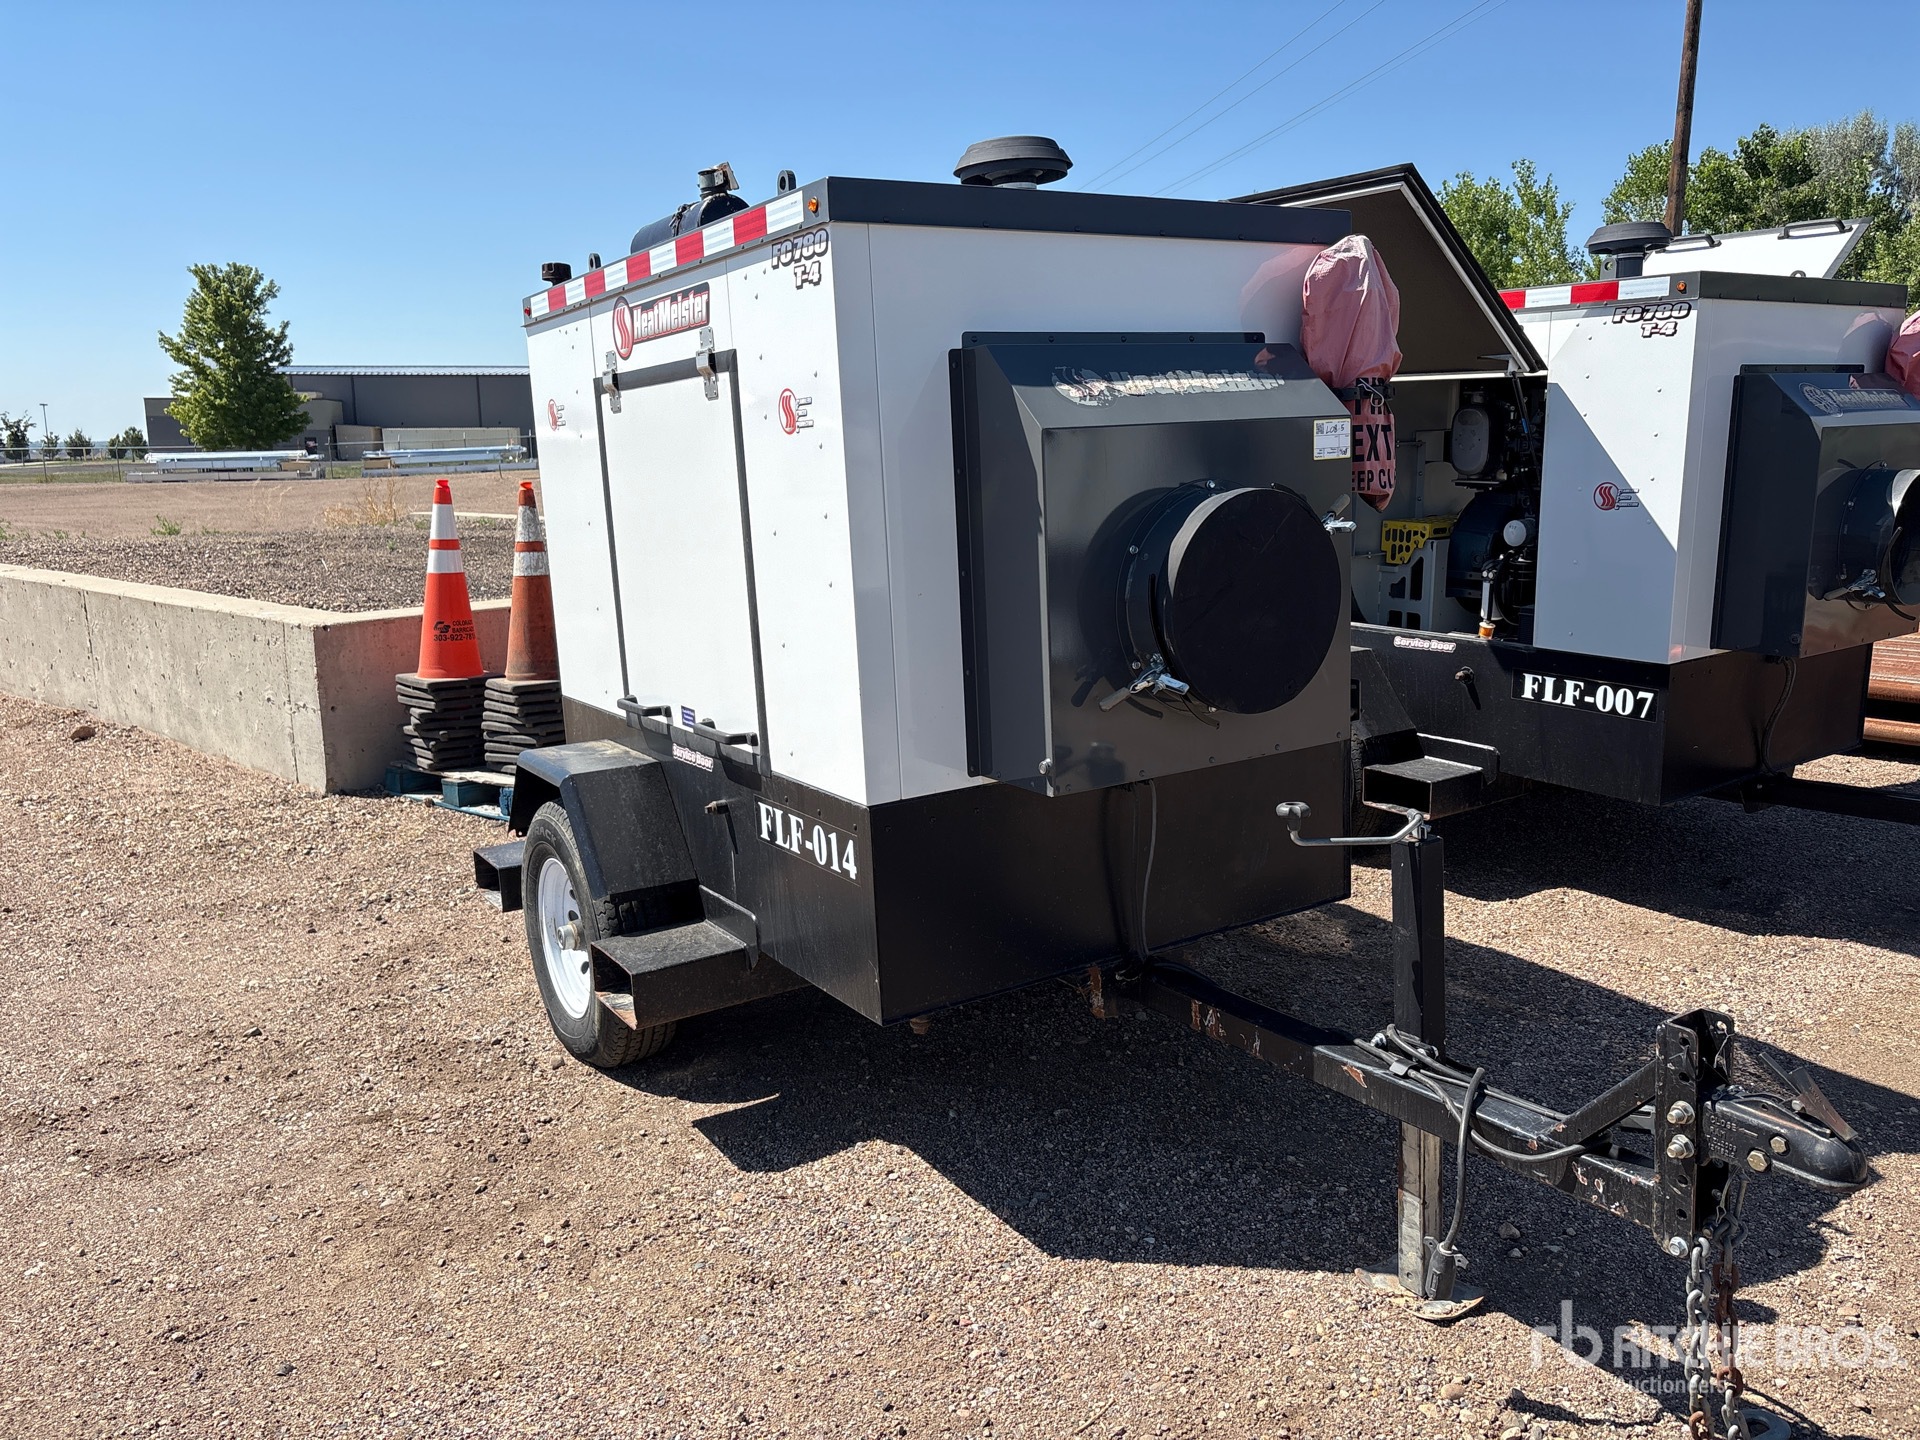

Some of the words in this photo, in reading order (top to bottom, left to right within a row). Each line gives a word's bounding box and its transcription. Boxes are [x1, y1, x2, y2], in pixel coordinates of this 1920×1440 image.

[771, 227, 829, 270] FC780
[793, 260, 822, 290] T-4
[633, 290, 709, 342] HeatMeister
[1612, 301, 1692, 324] FC780
[1641, 321, 1678, 338] T-4
[1394, 636, 1430, 650] Service
[1429, 640, 1456, 653] Door
[1521, 673, 1654, 719] FLF-007
[672, 743, 696, 765] Service
[695, 751, 714, 772] Door
[757, 801, 858, 880] FLF-014
